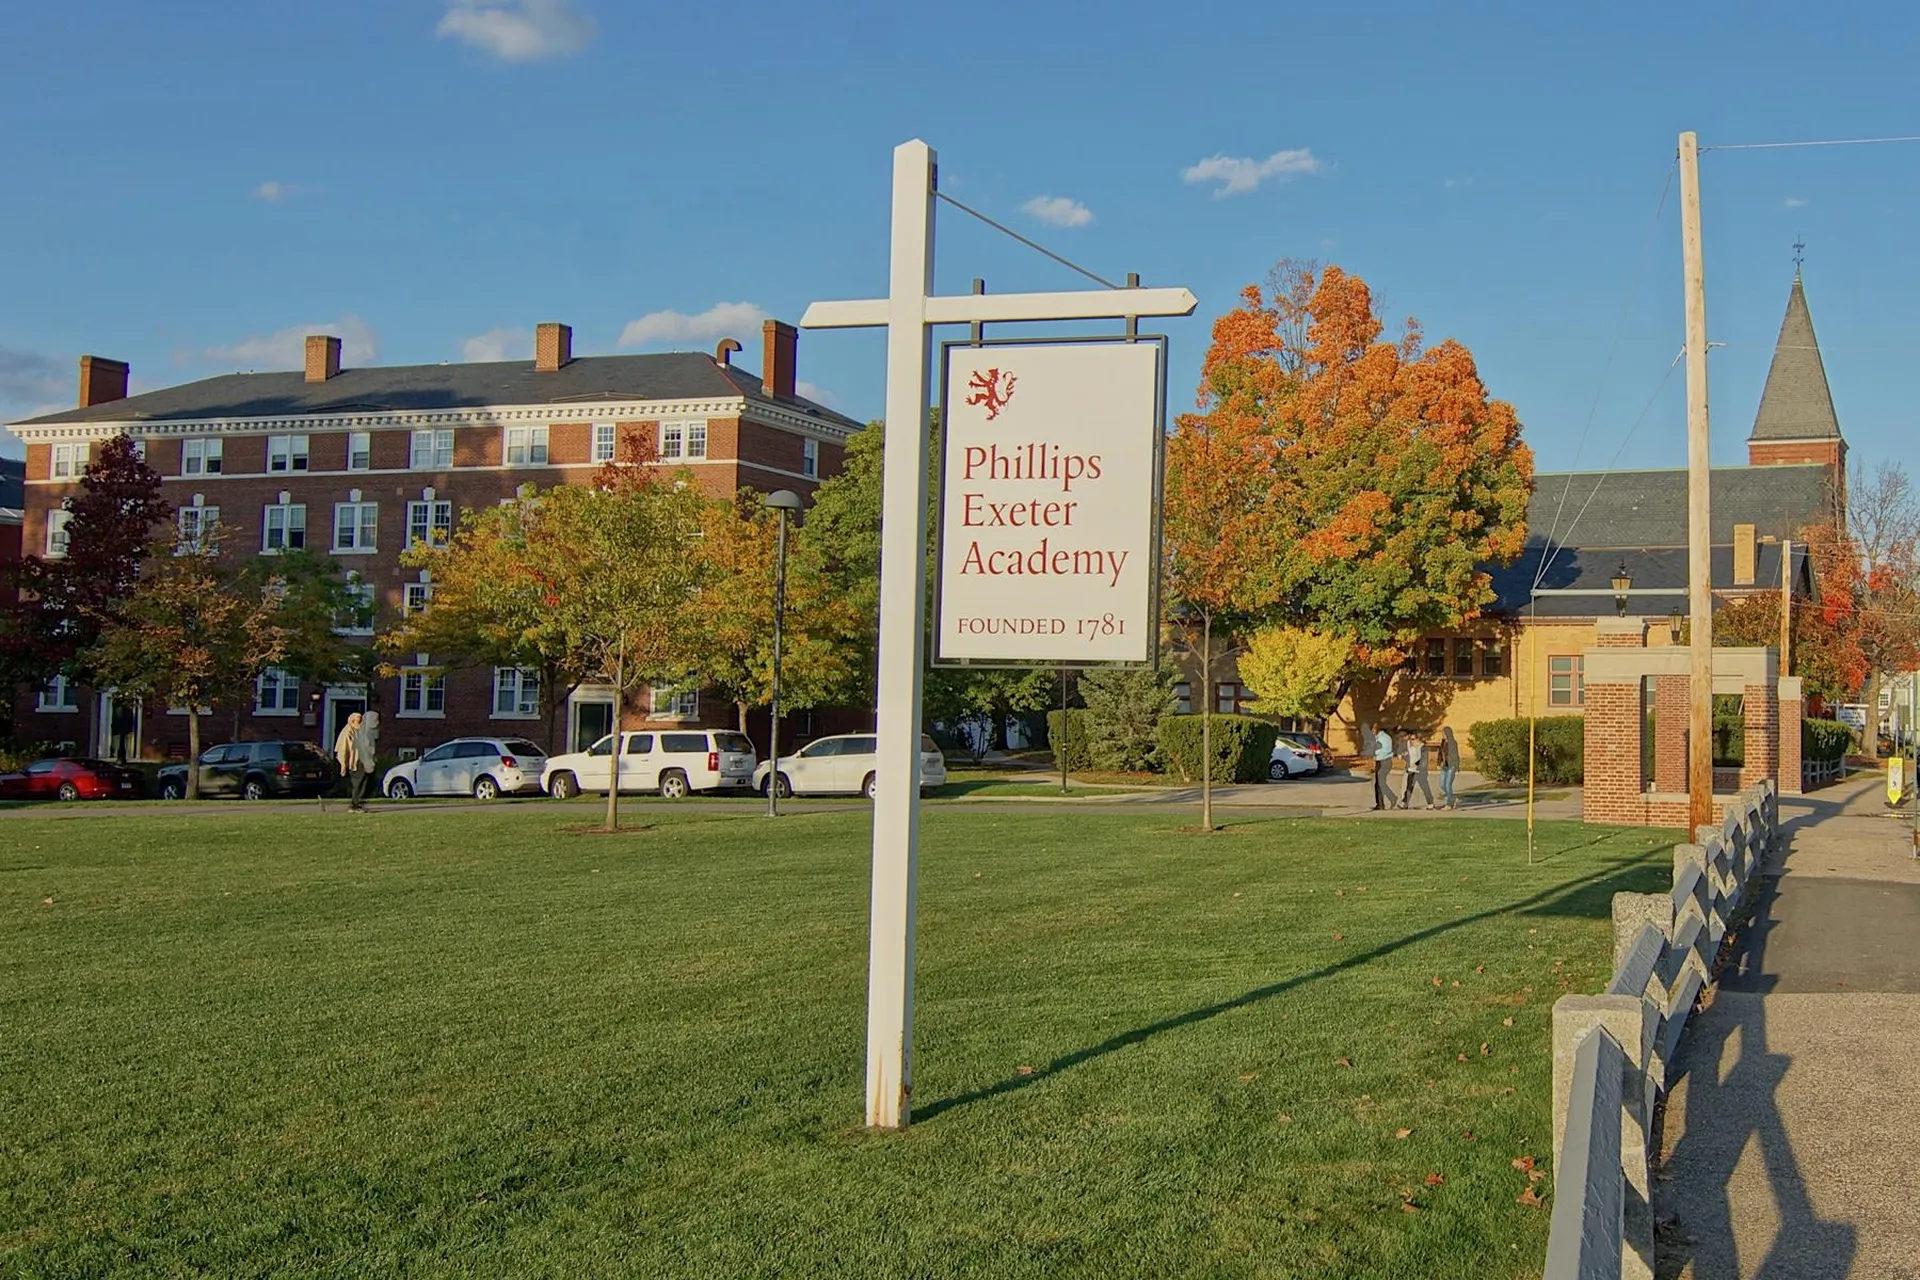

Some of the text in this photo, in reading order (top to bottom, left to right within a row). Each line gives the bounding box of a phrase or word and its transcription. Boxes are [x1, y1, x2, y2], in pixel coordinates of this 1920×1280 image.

[963, 443, 1102, 492] Phillips
[962, 493, 1078, 527] Exeter
[960, 538, 1129, 588] Academy
[958, 613, 1126, 641] FOUNDED 1781
